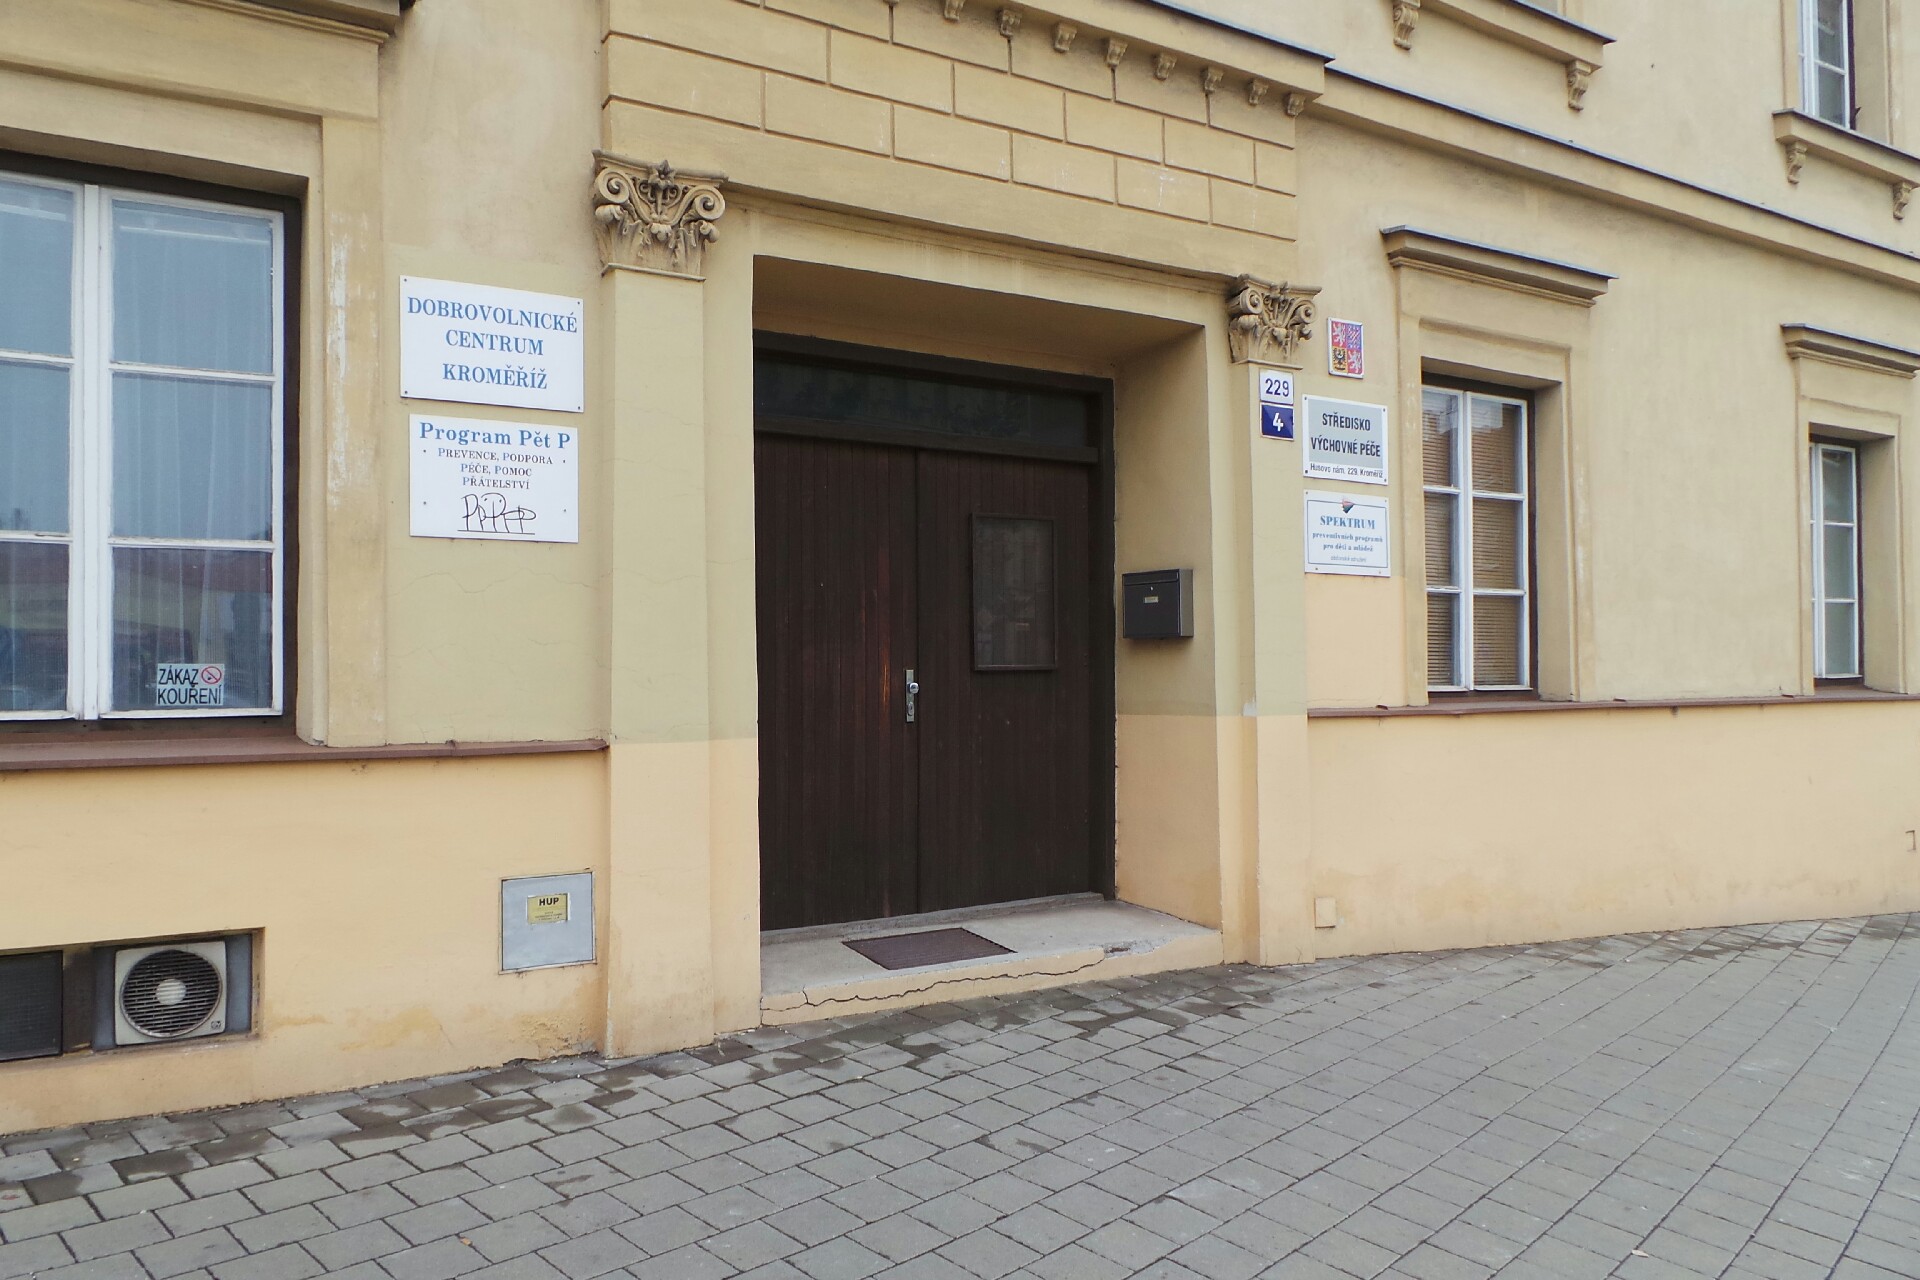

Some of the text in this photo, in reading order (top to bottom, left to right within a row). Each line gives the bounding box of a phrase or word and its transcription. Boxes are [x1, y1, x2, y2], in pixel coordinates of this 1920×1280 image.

[407, 297, 578, 333] DOBROVOLNICKÉ
[445, 329, 544, 356] CENTRUM
[442, 363, 548, 389] KROMĚŘÍŽ
[1265, 378, 1290, 397] 229
[1272, 412, 1284, 431] 4
[1322, 412, 1371, 431] STŘEDISKO
[419, 422, 571, 449] Program Pět P
[1310, 435, 1381, 457] VÝCHOVNÉ PÉČE
[438, 448, 553, 465] PREVENCE, PODPORA
[460, 462, 532, 477] PÉČE, POMOC
[462, 476, 530, 490] PŘÁTELSTVÍ
[1320, 515, 1375, 530] SPEKTRUM
[158, 665, 199, 685] ZÁKAZ
[158, 684, 222, 704] KOUŘENÍ
[539, 898, 559, 906] HUP
